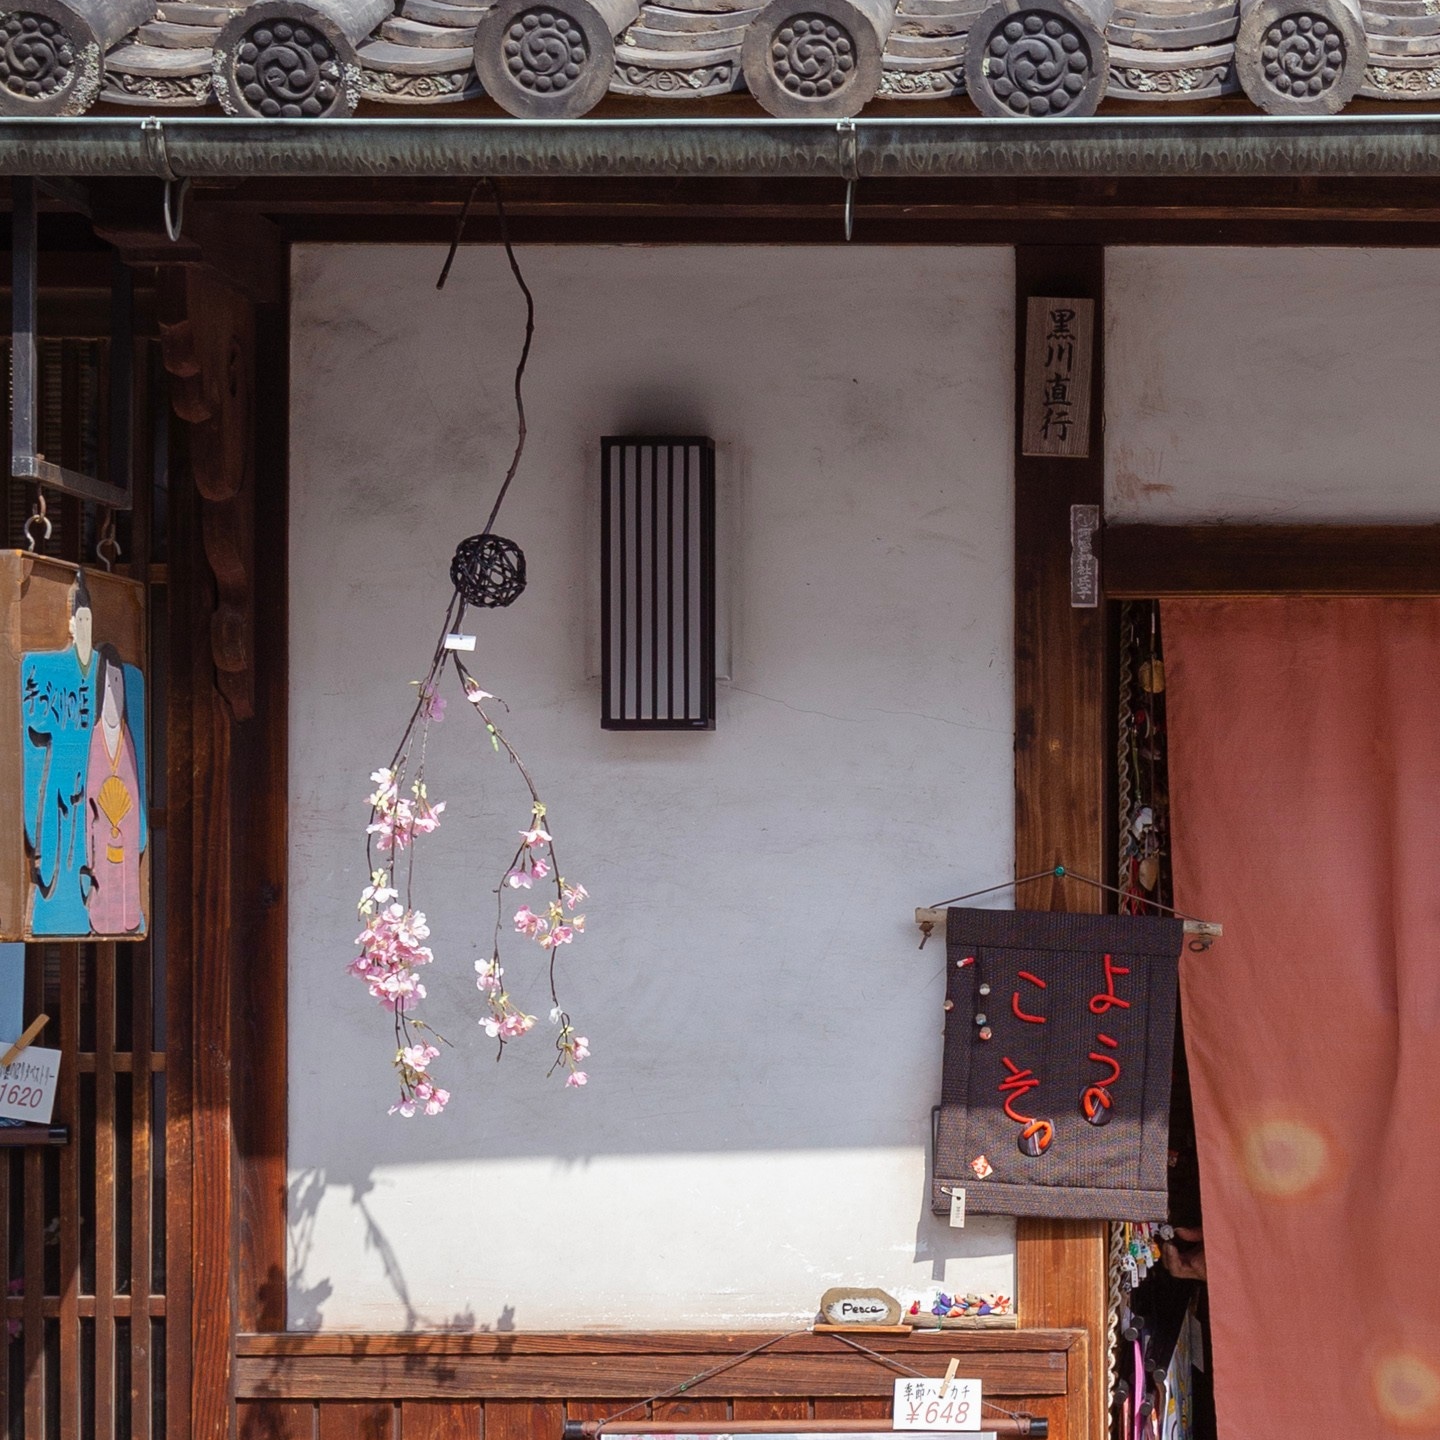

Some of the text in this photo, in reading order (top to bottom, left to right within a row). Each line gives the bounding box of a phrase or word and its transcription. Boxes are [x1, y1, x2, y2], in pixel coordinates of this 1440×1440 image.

[1039, 308, 1077, 442] 黒川直行
[904, 1381, 971, 1402] 季節ハカチ
[905, 1401, 971, 1425] ¥648
